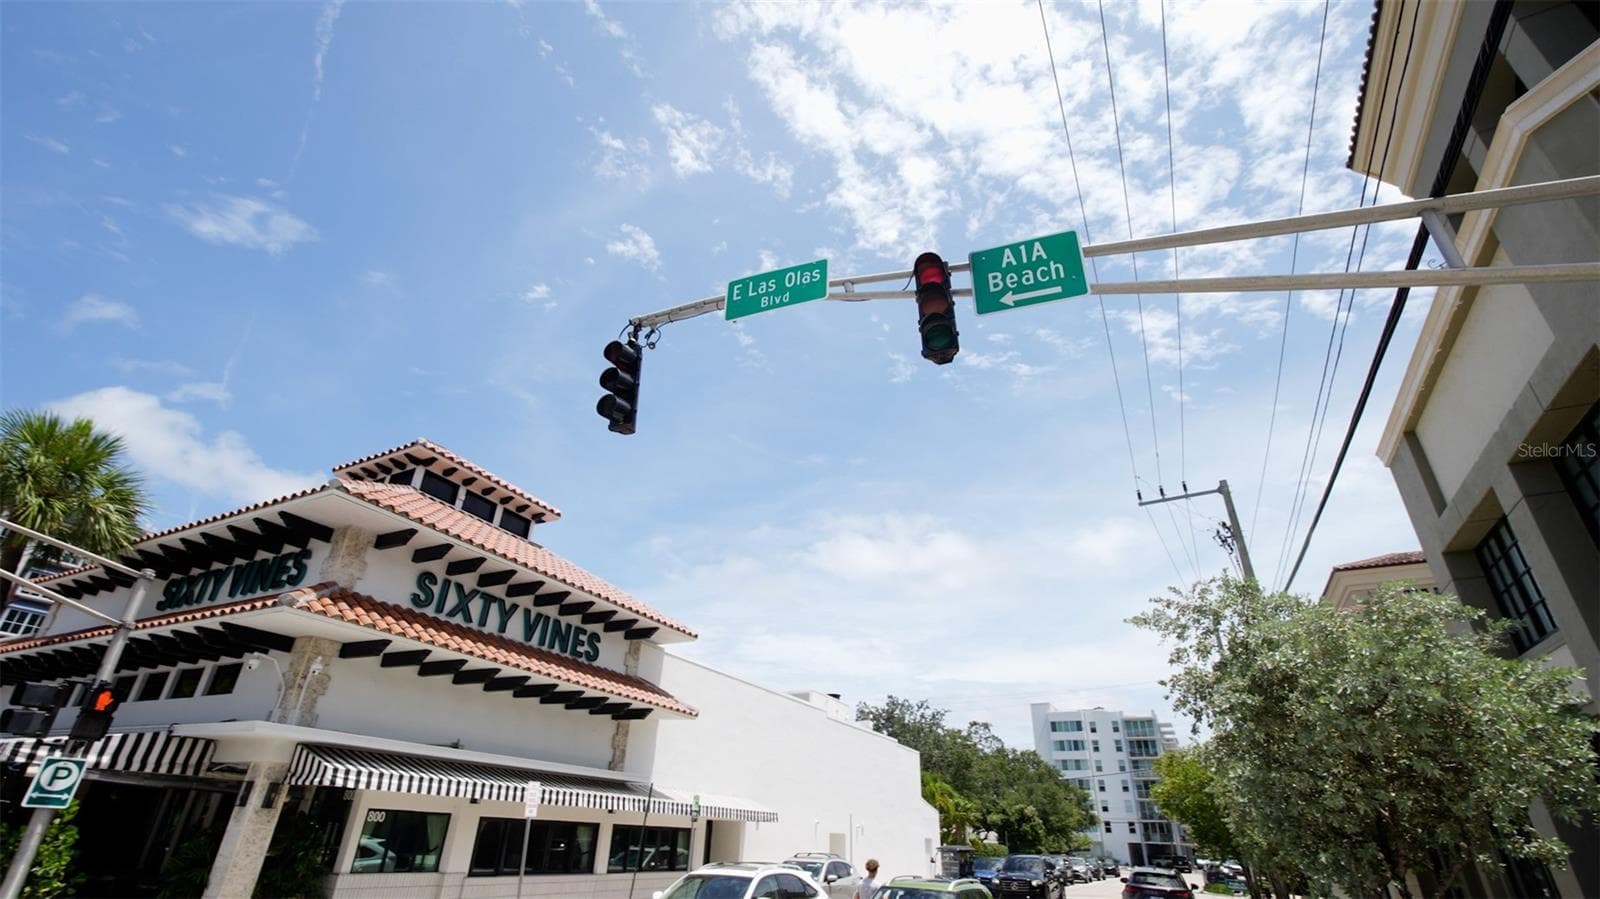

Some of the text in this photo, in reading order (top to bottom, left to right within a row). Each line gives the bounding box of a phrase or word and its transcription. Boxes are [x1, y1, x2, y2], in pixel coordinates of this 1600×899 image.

[1001, 241, 1048, 269] A1A
[733, 269, 821, 301] E Las Olas
[988, 260, 1065, 293] Beach
[760, 292, 790, 308] Blvd
[156, 549, 312, 611] SIXTY VINES
[410, 571, 601, 662] SIXTY VINES
[47, 766, 73, 787] P
[367, 810, 386, 822] 800
